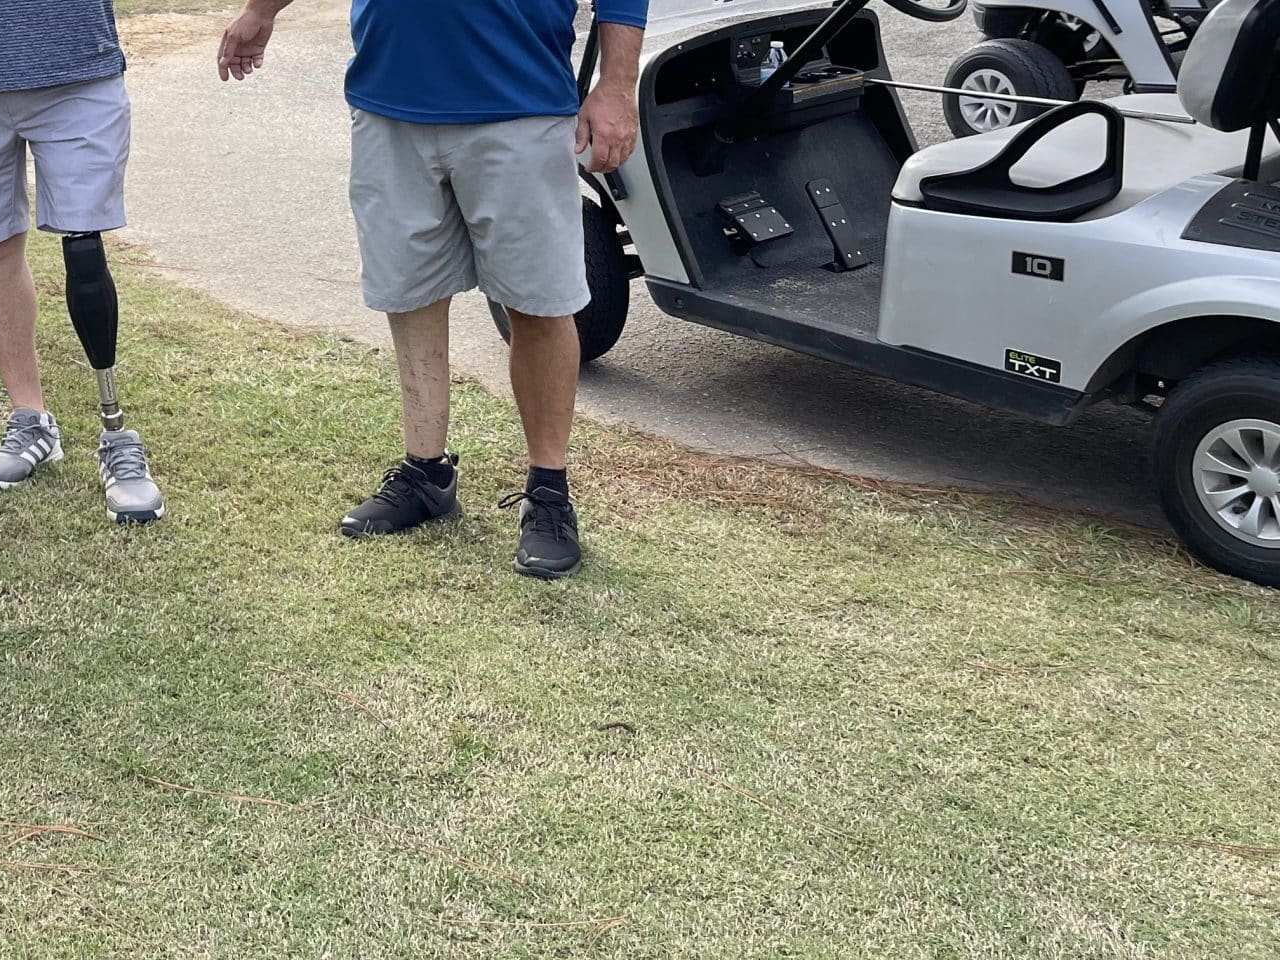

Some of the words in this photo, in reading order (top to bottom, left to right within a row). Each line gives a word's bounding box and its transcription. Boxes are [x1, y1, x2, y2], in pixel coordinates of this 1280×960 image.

[1025, 257, 1052, 275] 10
[1009, 351, 1036, 363] ELITE
[1009, 359, 1057, 379] TXT
